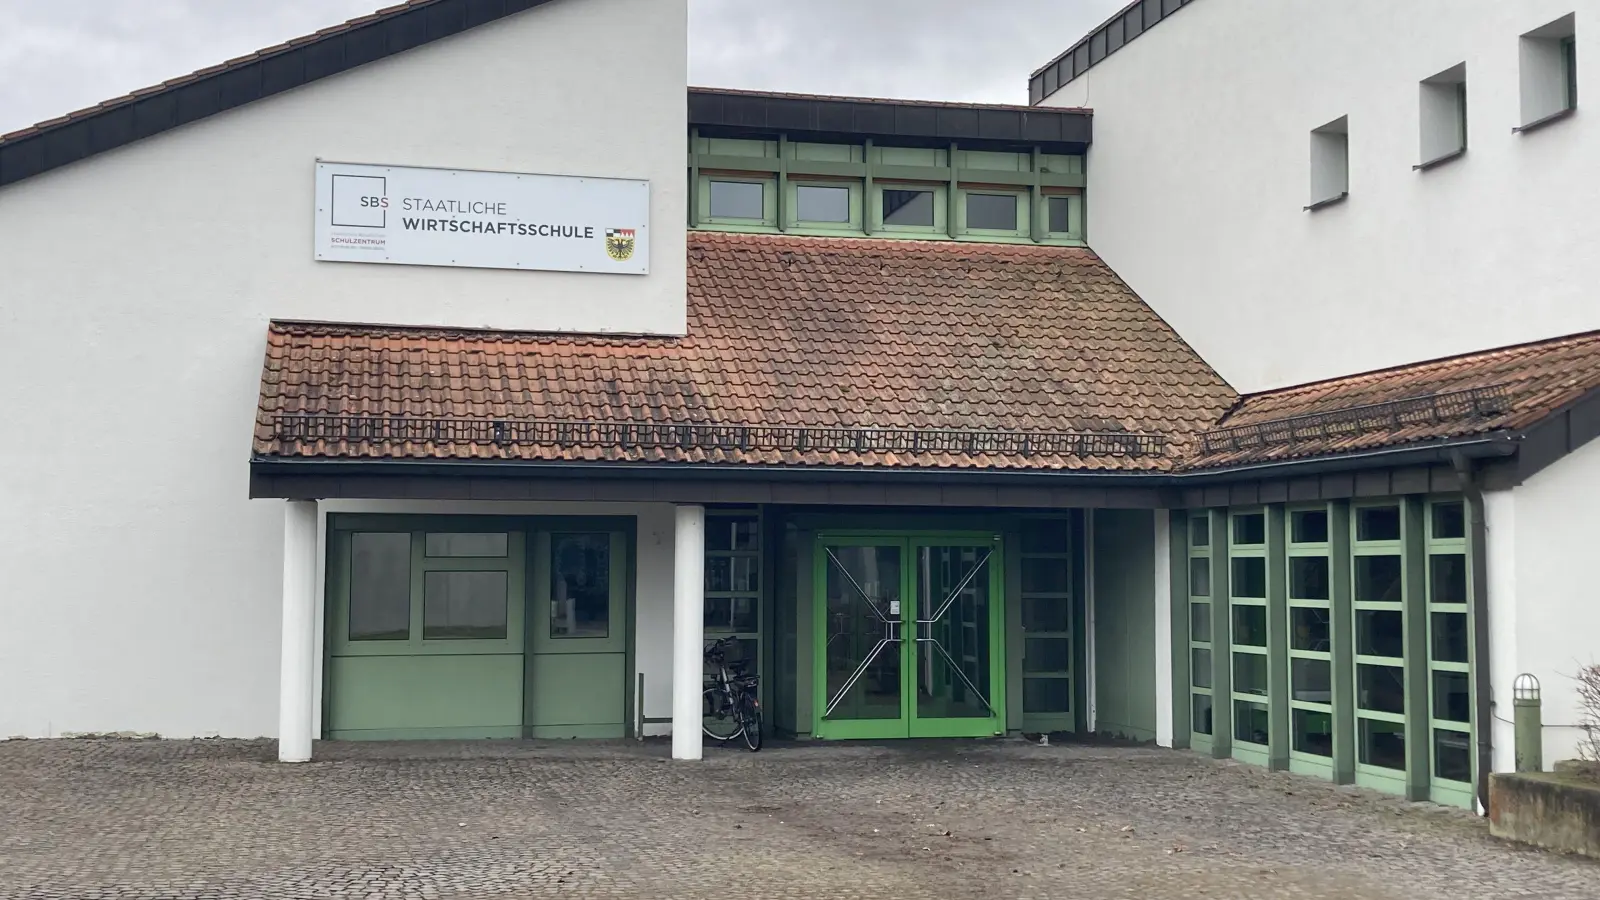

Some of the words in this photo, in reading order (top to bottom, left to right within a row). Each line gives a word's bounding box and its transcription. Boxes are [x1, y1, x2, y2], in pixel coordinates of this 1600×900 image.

[360, 196, 389, 208] SBS
[402, 198, 507, 215] STAATLICHE
[402, 218, 594, 239] WIRTSCHAFTSSCHULE
[331, 237, 386, 245] SCHULZENTRUM
